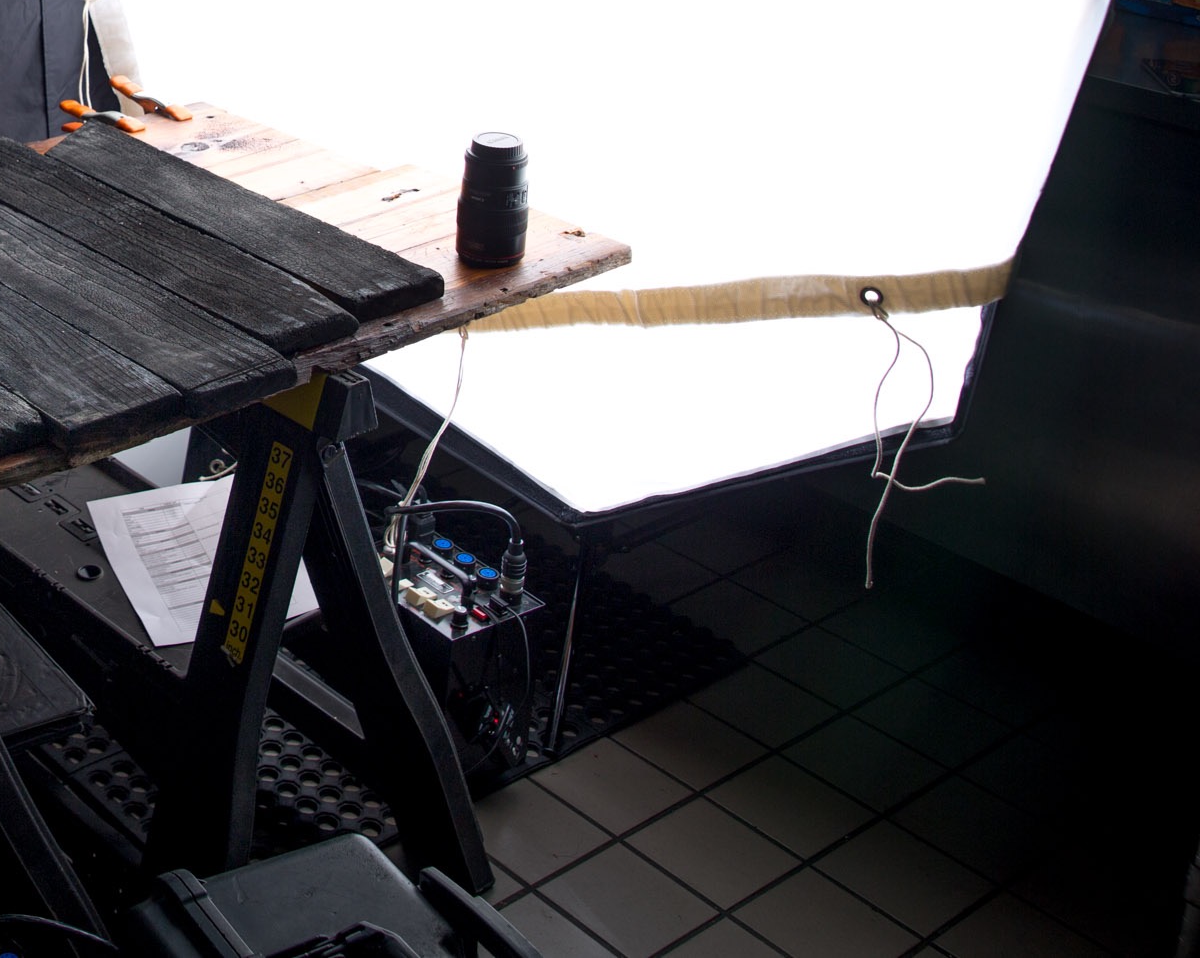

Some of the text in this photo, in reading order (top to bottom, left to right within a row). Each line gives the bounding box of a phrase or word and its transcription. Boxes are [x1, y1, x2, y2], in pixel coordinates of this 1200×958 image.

[270, 446, 291, 469] 37
[264, 471, 284, 494] 36
[259, 496, 279, 520] 35
[253, 522, 272, 545] 34
[247, 547, 266, 570] 33
[241, 571, 260, 595] 32
[235, 596, 254, 619] 31
[229, 620, 248, 643] 30
